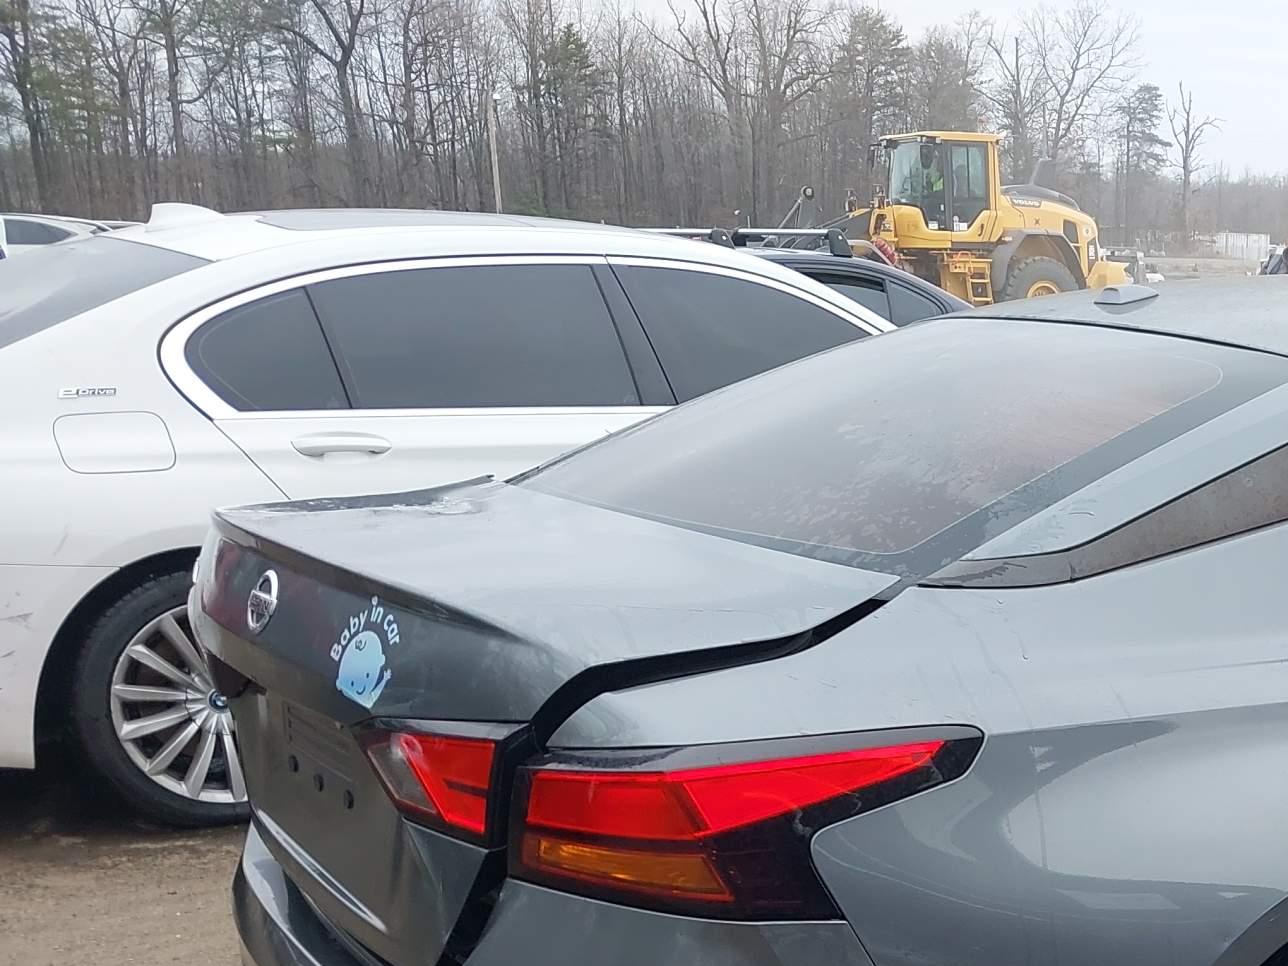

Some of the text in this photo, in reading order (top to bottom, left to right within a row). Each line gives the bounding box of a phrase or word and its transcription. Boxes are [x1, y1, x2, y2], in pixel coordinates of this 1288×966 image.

[330, 595, 400, 661] Baby in car
